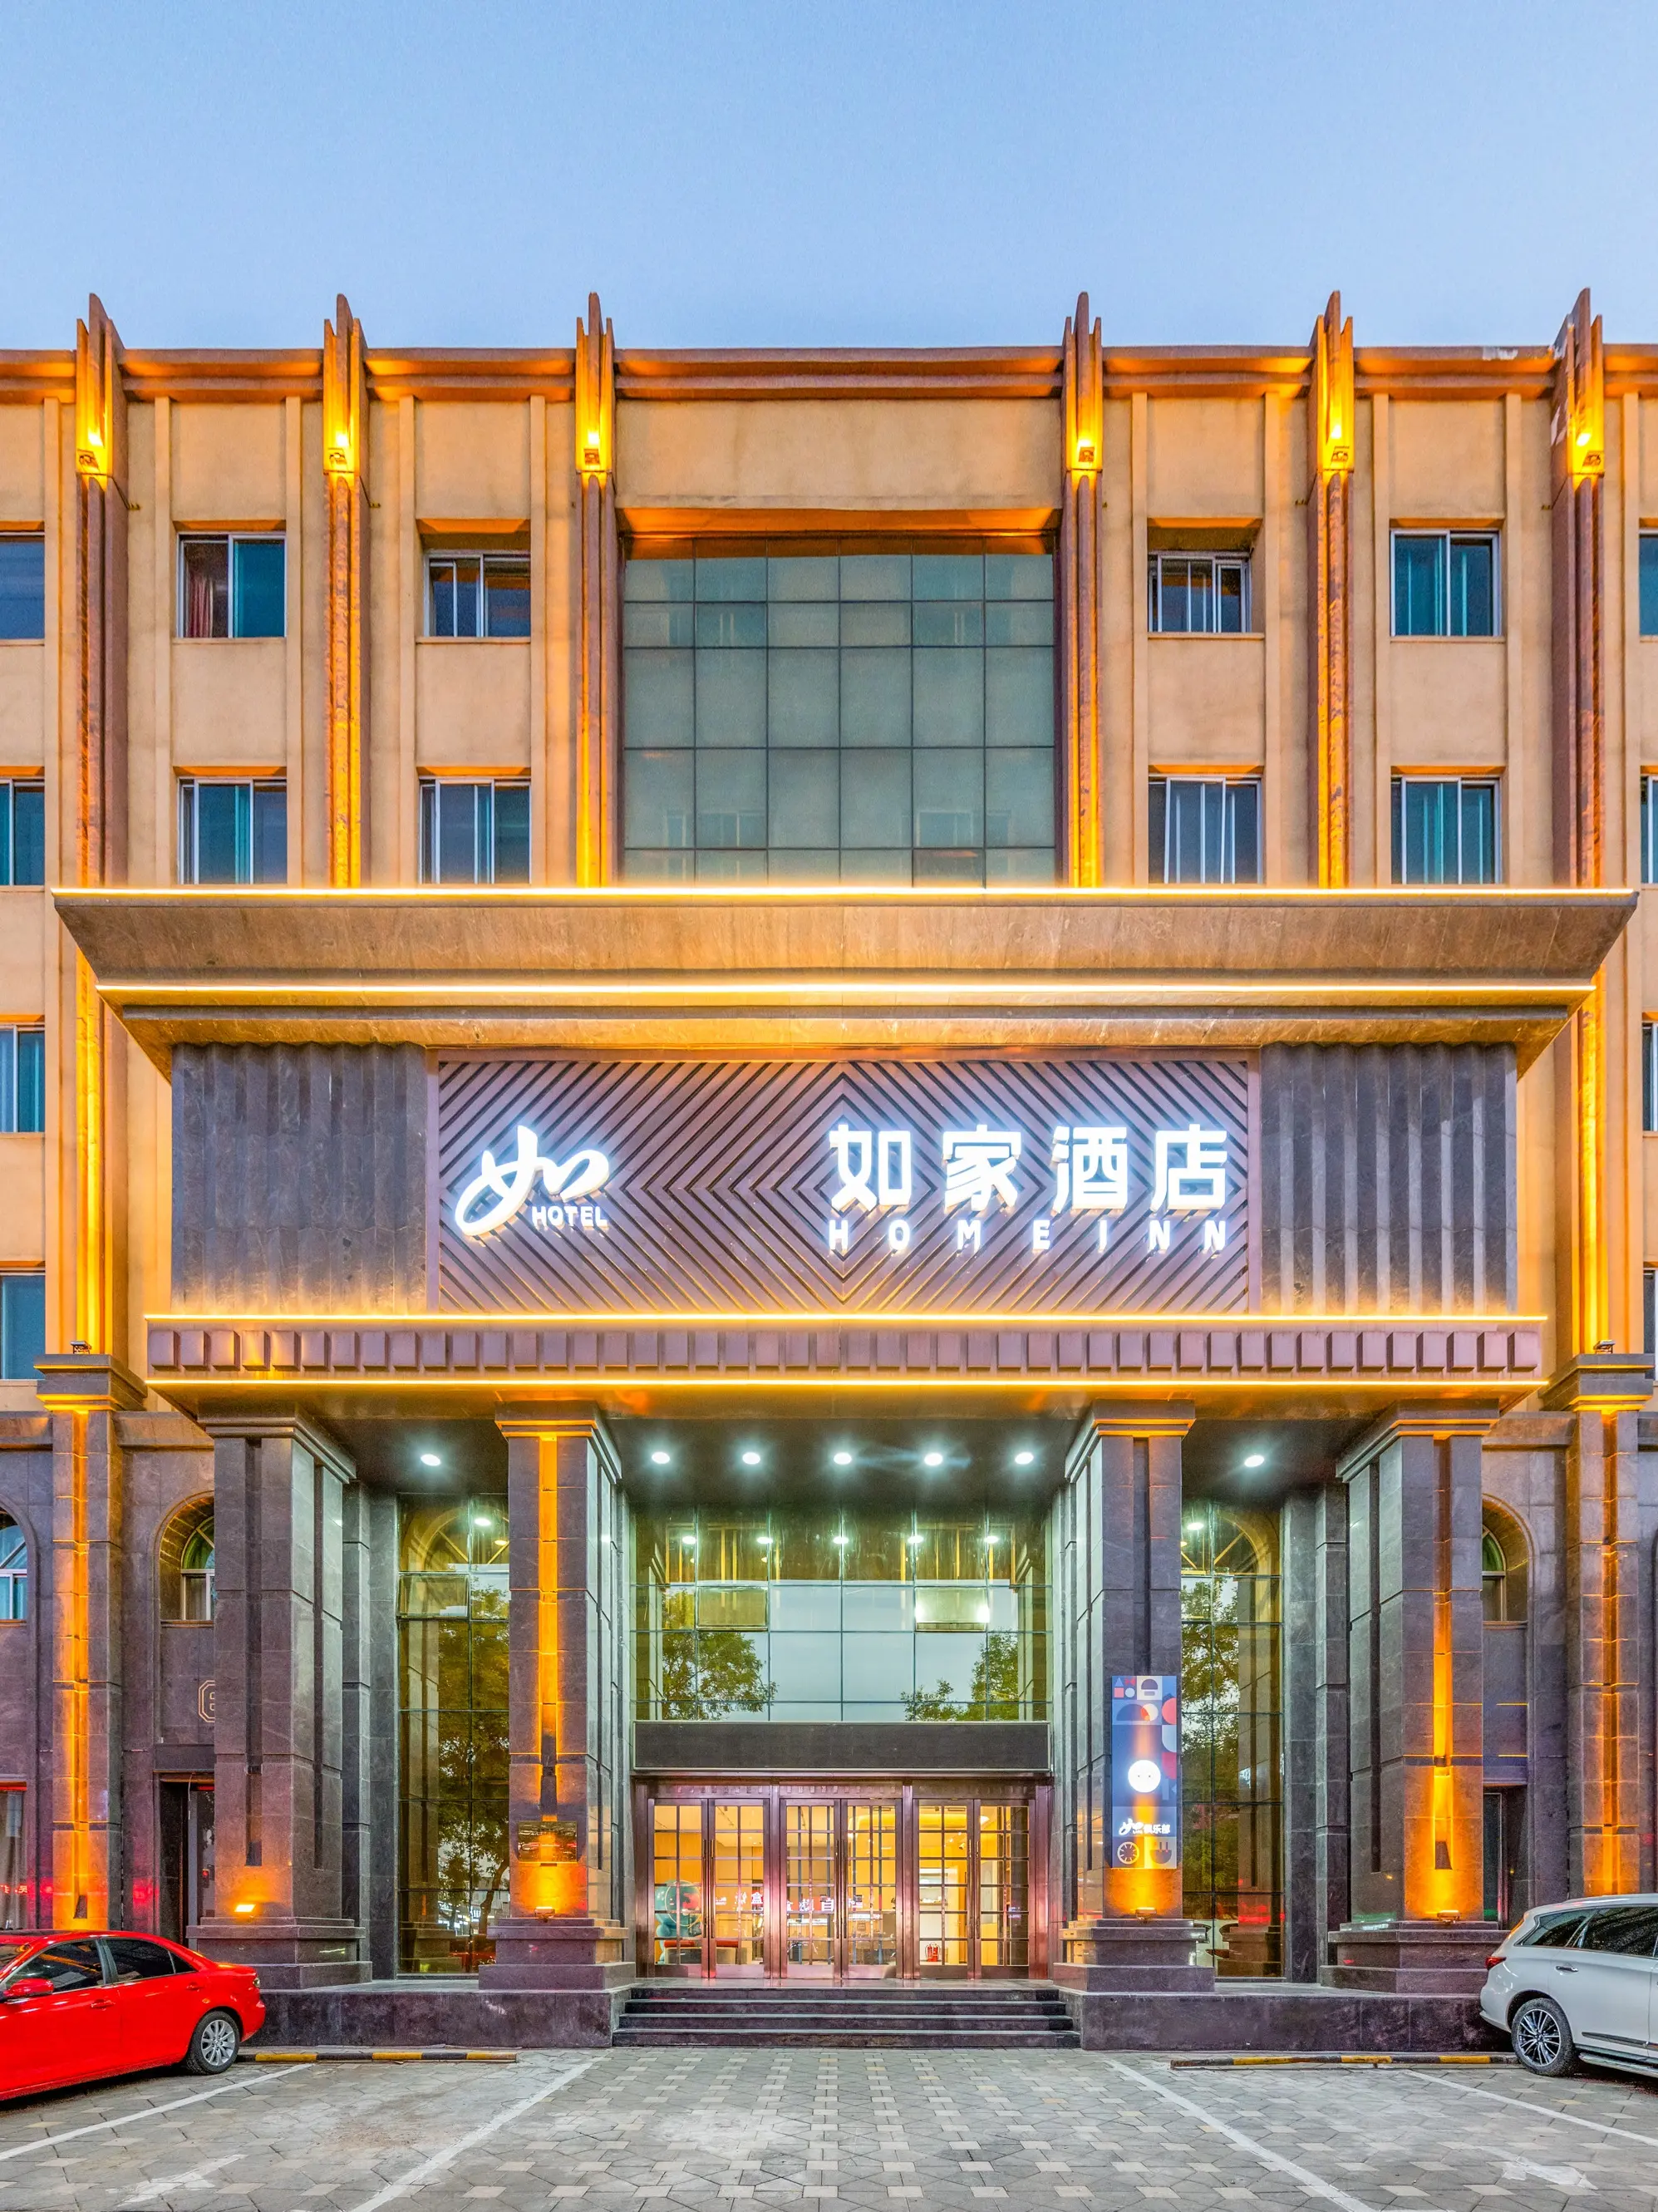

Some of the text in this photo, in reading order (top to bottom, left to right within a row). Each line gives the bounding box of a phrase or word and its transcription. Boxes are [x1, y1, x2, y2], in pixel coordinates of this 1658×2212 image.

[829, 1124, 1228, 1213] 如家酒店
[532, 1205, 608, 1228] HOTEL
